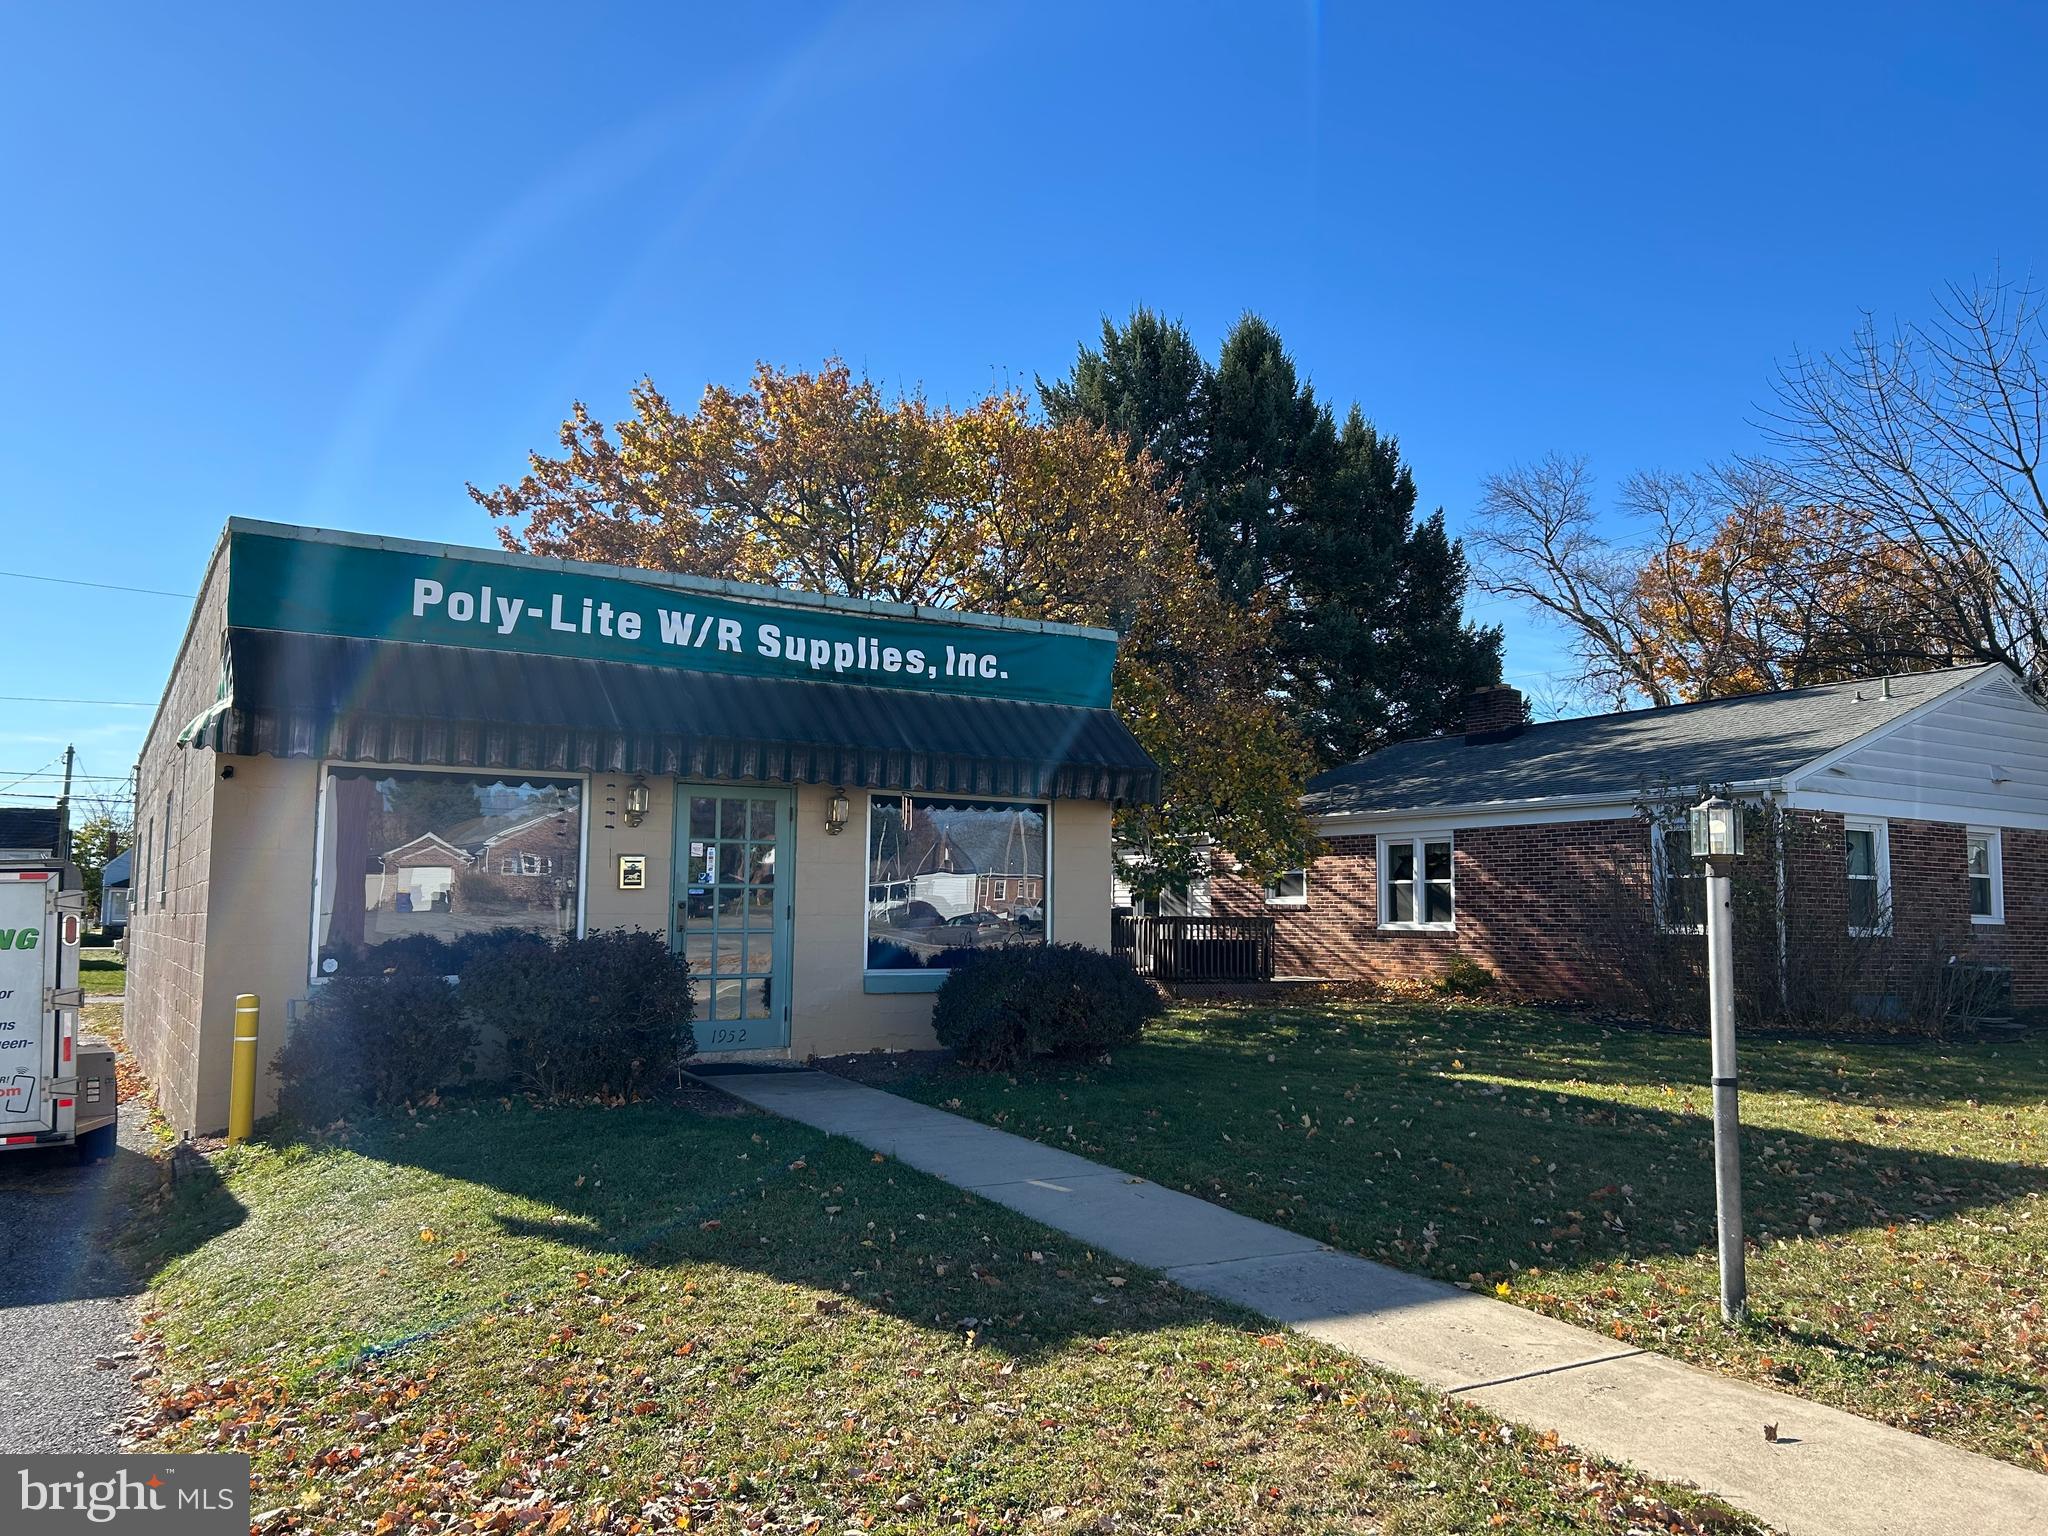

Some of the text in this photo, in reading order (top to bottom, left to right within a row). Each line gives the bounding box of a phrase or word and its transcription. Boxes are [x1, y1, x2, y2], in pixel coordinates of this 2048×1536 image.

[412, 578, 1009, 680] Poly-Lite W/R Supplies, Inc.
[0, 927, 40, 950] NG
[0, 1039, 34, 1049] een-
[711, 1028, 747, 1043] 1952
